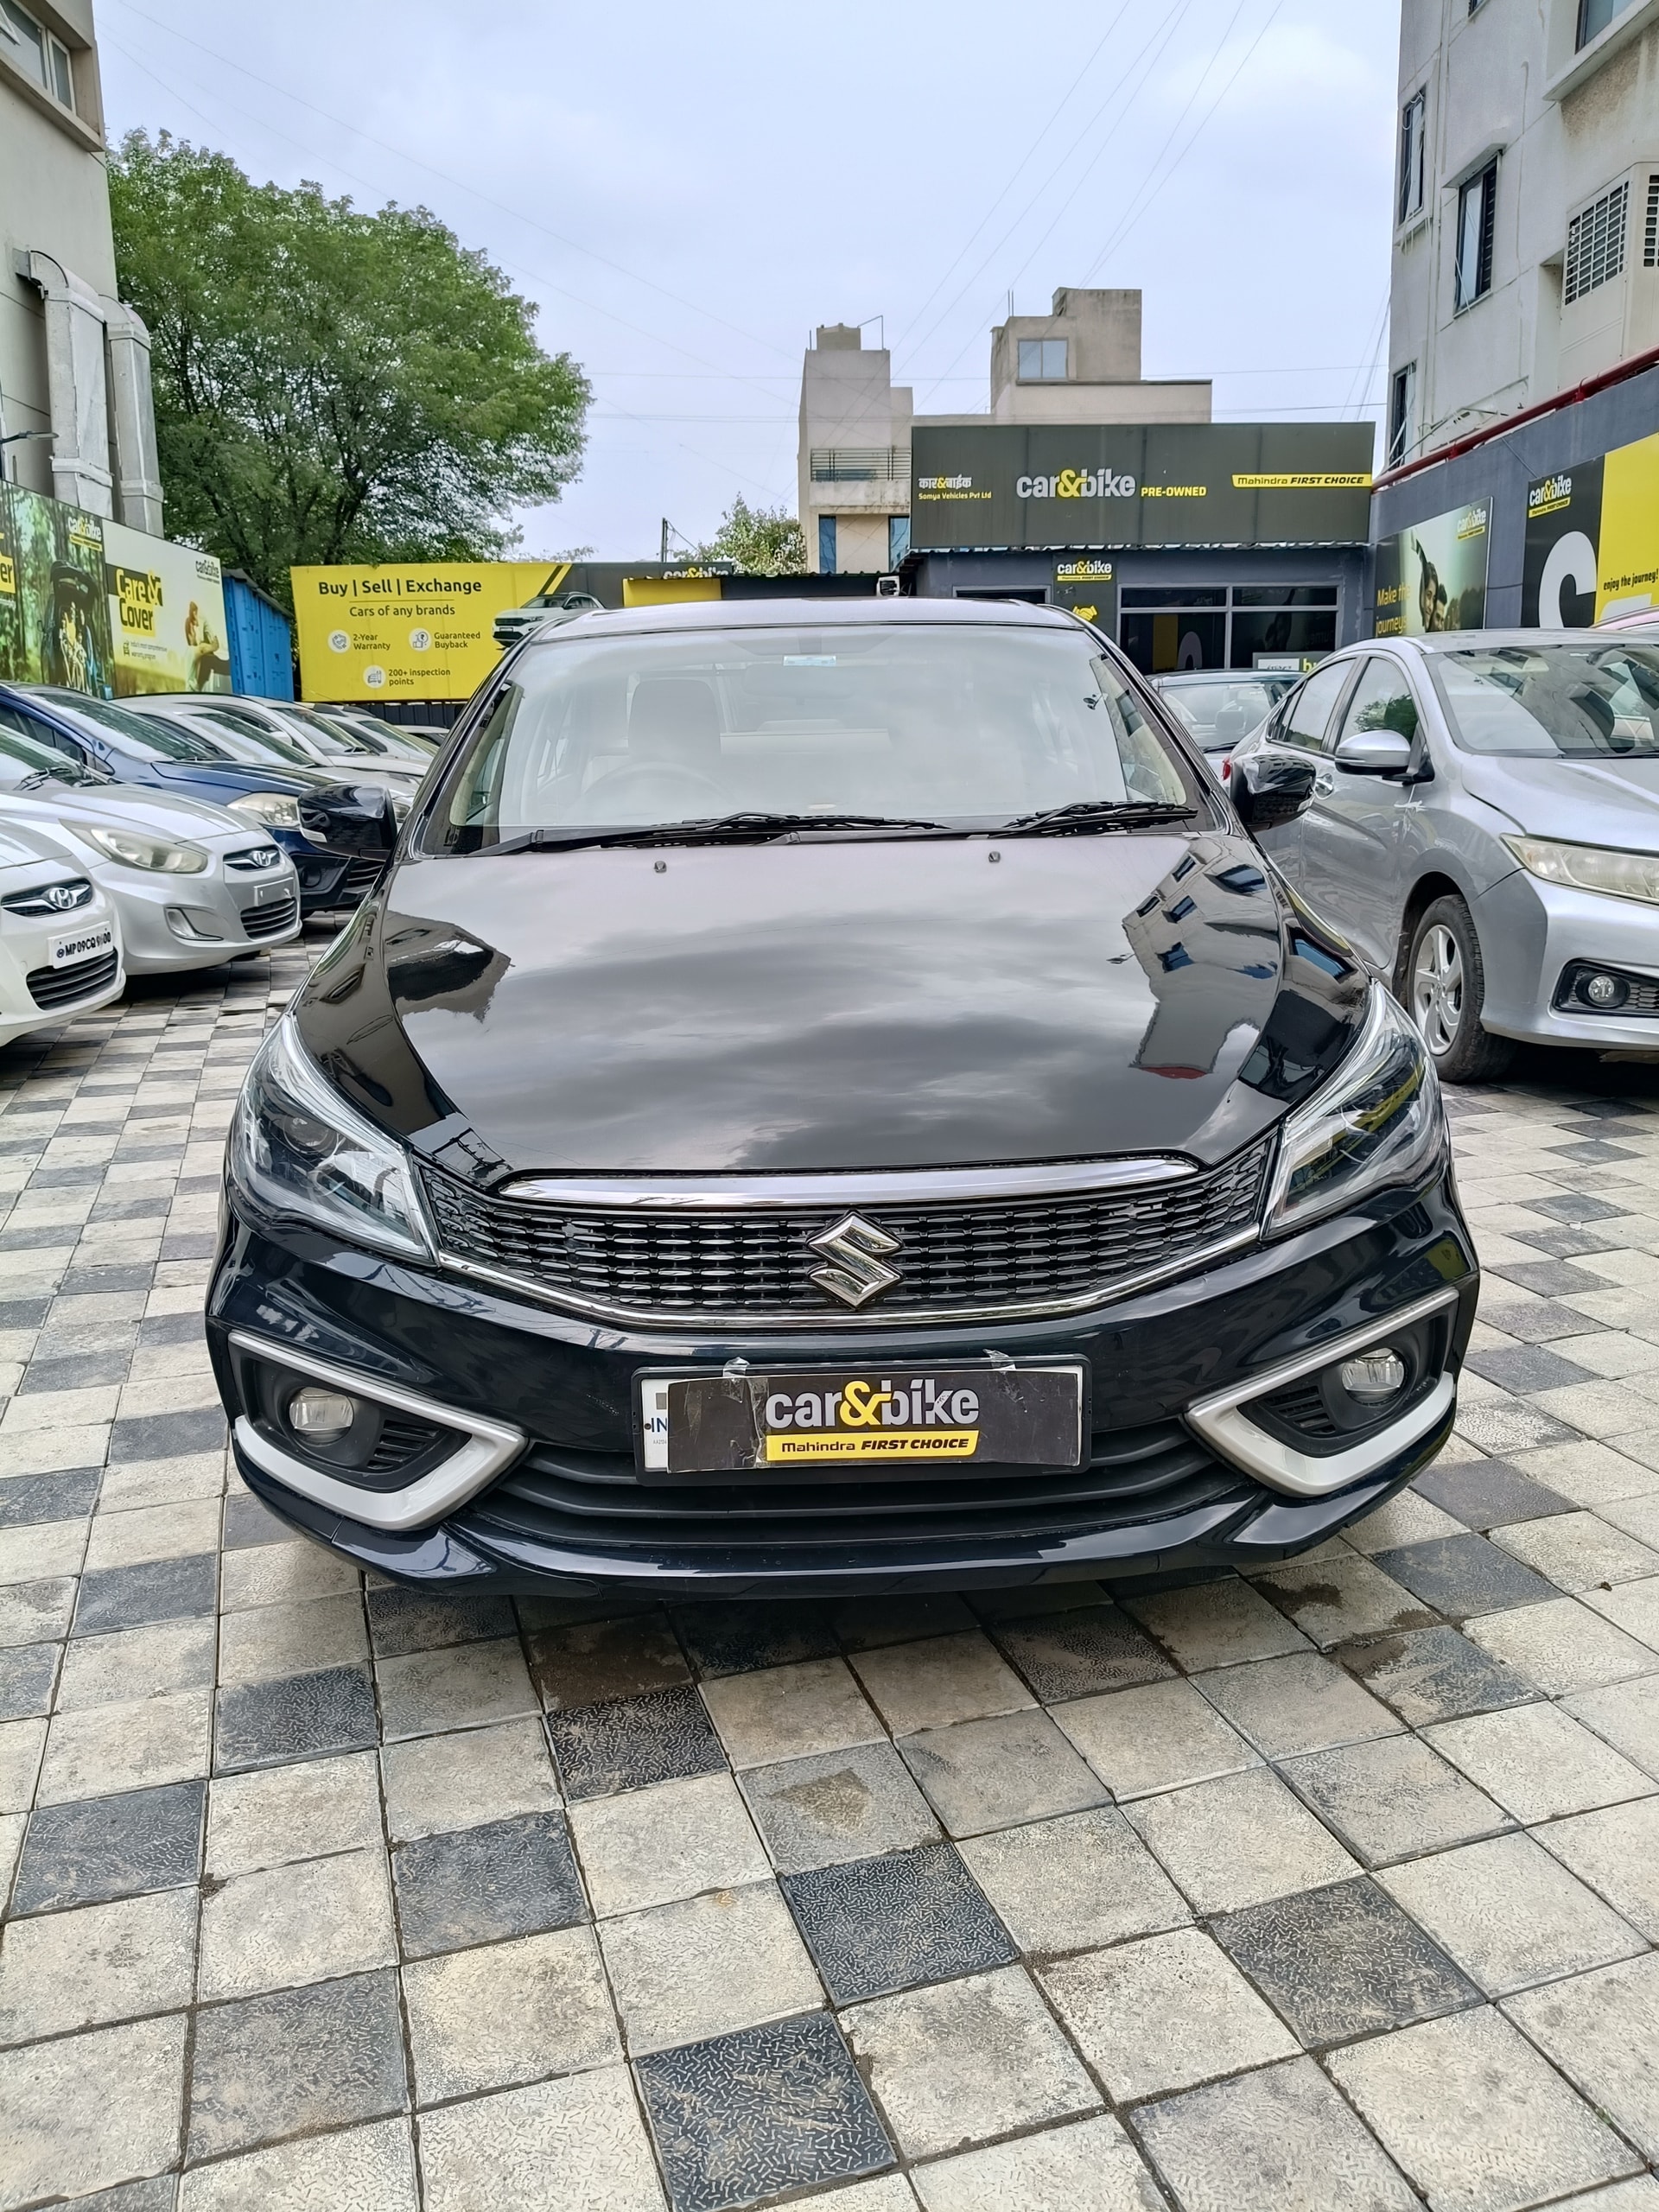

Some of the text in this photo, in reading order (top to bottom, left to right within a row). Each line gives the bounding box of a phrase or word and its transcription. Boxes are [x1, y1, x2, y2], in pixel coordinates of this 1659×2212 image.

[1016, 468, 1207, 499] car&bike PRE-OWNED
[1529, 474, 1572, 507] car&bike
[1057, 560, 1112, 575] car&bike
[116, 568, 145, 602] Care
[318, 582, 348, 598] Buy
[362, 578, 393, 594] Sell
[406, 577, 482, 595] Exchange
[1603, 568, 1659, 593] enjoy the journey!
[1376, 585, 1398, 607] Make
[119, 597, 154, 632] Cover
[349, 604, 456, 618] Cars of any brands
[434, 632, 481, 640] Guaranteed
[435, 640, 468, 650] Buyback
[353, 642, 391, 651] Warranty
[410, 668, 451, 677] inspection
[389, 677, 415, 687] points
[765, 1379, 980, 1428] car&bike
[781, 1438, 969, 1452] Mahindra FIRST CHOICE
